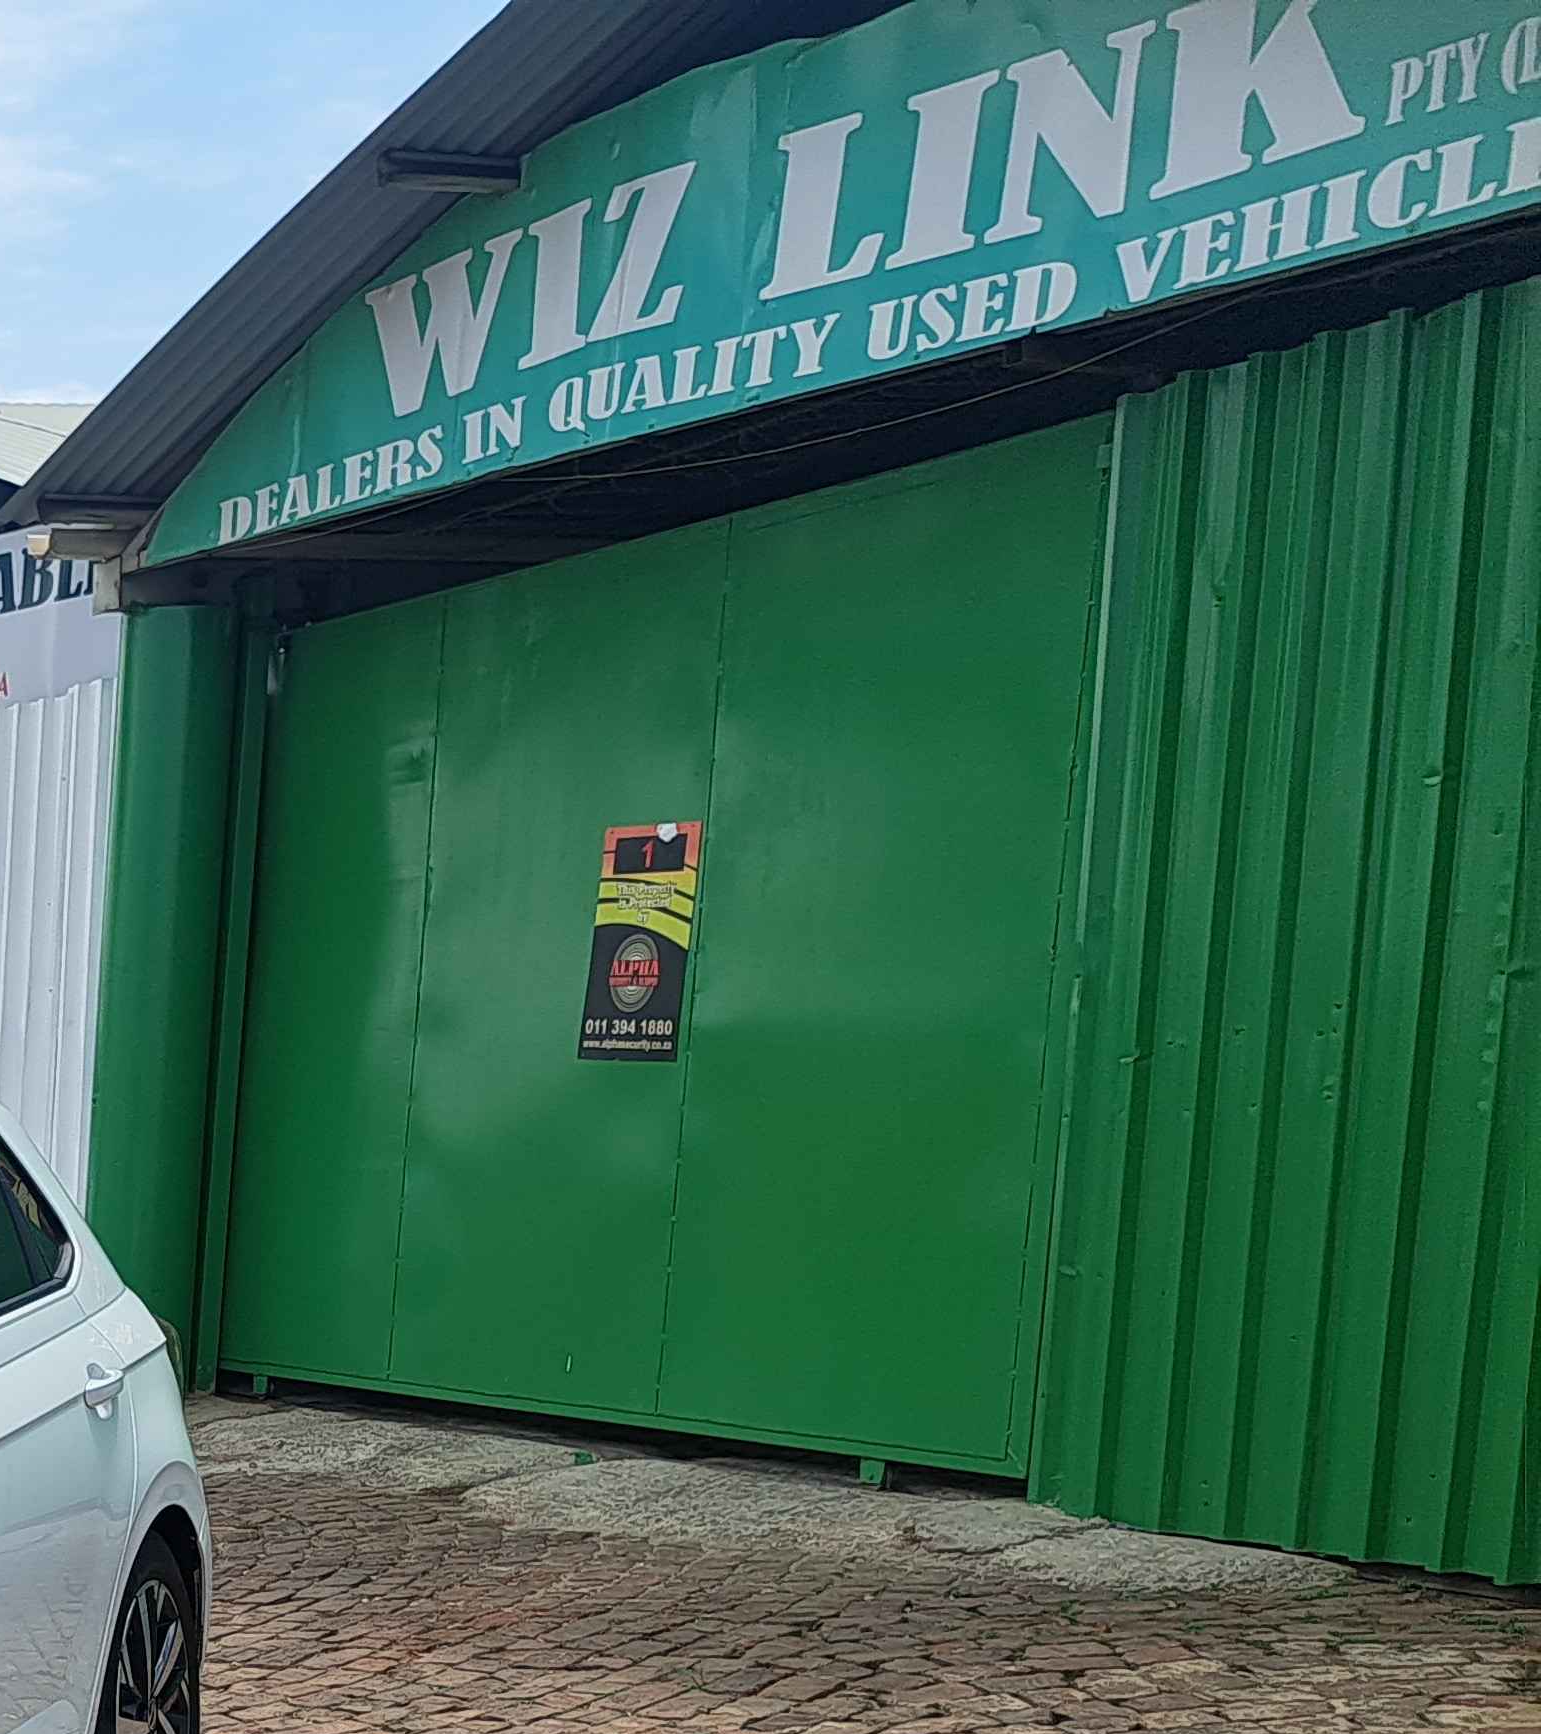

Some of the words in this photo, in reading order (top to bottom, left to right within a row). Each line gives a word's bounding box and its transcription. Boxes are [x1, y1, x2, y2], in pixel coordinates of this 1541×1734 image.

[366, 160, 699, 418] WIZ
[758, 0, 1367, 302] LINK
[1384, 32, 1491, 126] PTY
[216, 426, 445, 548] DEALERS
[461, 399, 526, 466] IN
[548, 312, 845, 434] QUALITY
[866, 262, 1078, 363] USED
[585, 1019, 607, 1035] 011
[611, 1019, 636, 1035] 394
[639, 1020, 673, 1036] 1880
[610, 959, 659, 977] ALPHA
